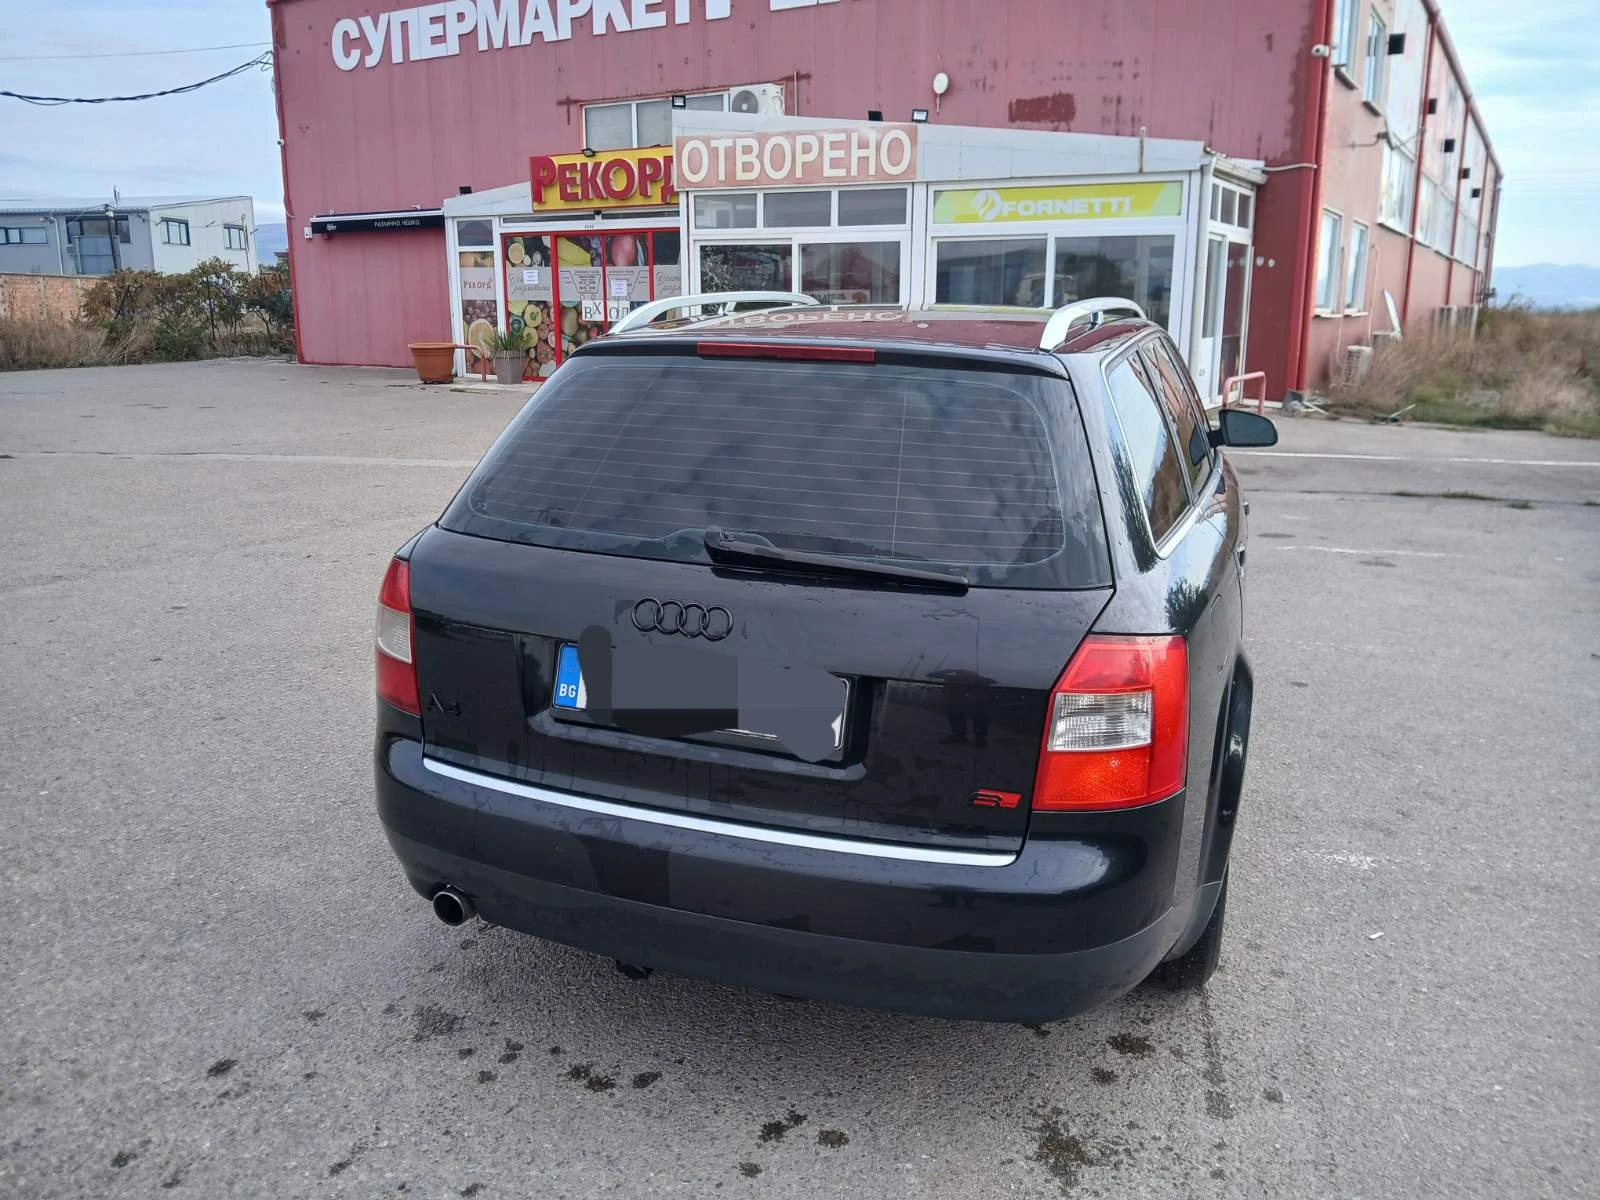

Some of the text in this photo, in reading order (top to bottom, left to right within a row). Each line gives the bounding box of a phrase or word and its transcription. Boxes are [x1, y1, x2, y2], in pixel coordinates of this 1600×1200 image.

[681, 128, 911, 183] ОТВОРЕНО
[1001, 196, 1132, 217] FORNETTI
[463, 280, 492, 290] РЕКОРД
[558, 683, 577, 698] BG
[427, 692, 462, 716] A4
